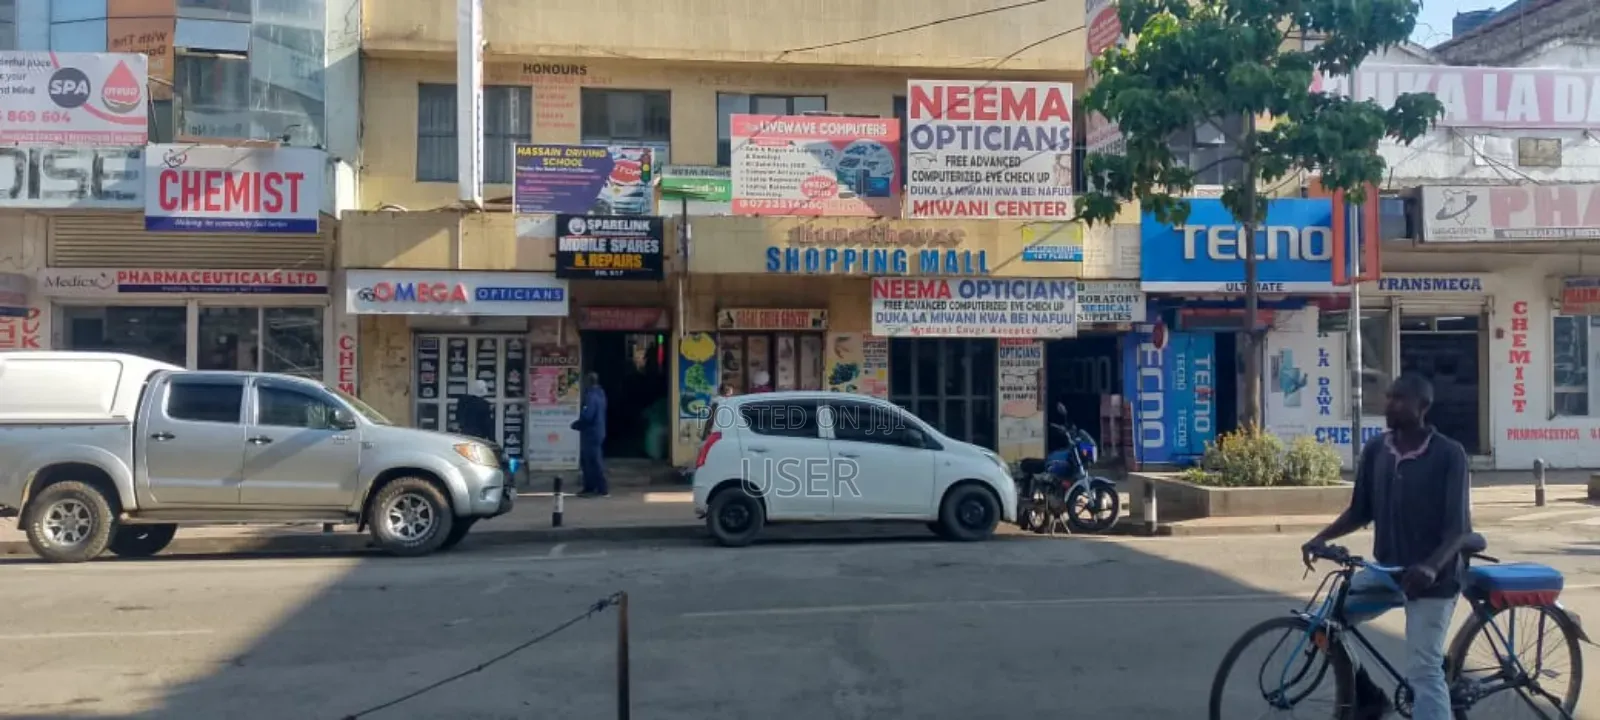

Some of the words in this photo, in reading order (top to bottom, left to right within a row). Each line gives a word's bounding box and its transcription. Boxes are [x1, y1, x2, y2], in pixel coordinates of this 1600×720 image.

[523, 63, 587, 75] HONOURS
[50, 80, 89, 95] SPA
[910, 85, 1071, 122] NEEMA
[1482, 73, 1541, 122] LA
[760, 120, 816, 134] LIVEWAVE
[820, 122, 887, 136] COMPUTERS
[910, 124, 1071, 151] OPTICIANS
[565, 148, 607, 158] DRIVING
[542, 158, 583, 167] SCHOOL
[945, 155, 970, 167] FREE
[970, 155, 1021, 168] ADVANCED
[912, 170, 981, 183] COMPUTERIZED
[985, 172, 1002, 183] EYE
[1005, 172, 1034, 183] CHECK
[1036, 172, 1050, 183] UP
[159, 169, 304, 213] CHEMIST
[910, 186, 938, 196] DUKA
[940, 187, 951, 196] LA
[954, 187, 993, 197] MIWANI
[995, 187, 1018, 197] KWA
[1021, 188, 1036, 197] BEI
[1038, 188, 1072, 197] NAFUU
[913, 201, 988, 217] MIWANI
[995, 201, 1067, 216] CENTER
[587, 218, 651, 231] SPARELINK
[559, 236, 606, 252] MOBILE
[610, 239, 659, 253] SPARES
[1177, 224, 1333, 261] TECNO
[588, 253, 642, 268] REPAIRS
[767, 246, 908, 274] SHOPPING
[919, 249, 990, 274] MALL
[117, 270, 282, 284] PHARMACEUTICALS
[287, 272, 318, 284] LTD
[1377, 278, 1482, 291] TRANSMEGA
[374, 282, 468, 303] OMEGA
[478, 288, 562, 300] OPTICIANS
[873, 280, 952, 299] NEEMA
[959, 280, 1076, 300] OPTICIANS
[1226, 282, 1284, 292] ULTATE
[884, 302, 903, 310] FREE
[904, 302, 946, 311] ADVANCED
[950, 302, 1007, 311] COMPUTERIZED
[1010, 302, 1025, 311] EYE
[1026, 302, 1052, 312] CHECK
[1053, 303, 1065, 312] UP
[875, 312, 908, 324] DUKA
[912, 312, 926, 324] LA
[930, 312, 976, 324] MIWANI
[980, 312, 1006, 324] KWA
[1010, 313, 1028, 324] BEI
[1032, 313, 1072, 325] NAFUU
[1000, 347, 1041, 358] OPTICIANS
[1508, 301, 1531, 413] CHEMIST
[1177, 353, 1187, 391] TECNO
[1195, 354, 1211, 433] TECNO
[1316, 378, 1333, 415] DAWA
[1178, 408, 1187, 447] TECNO
